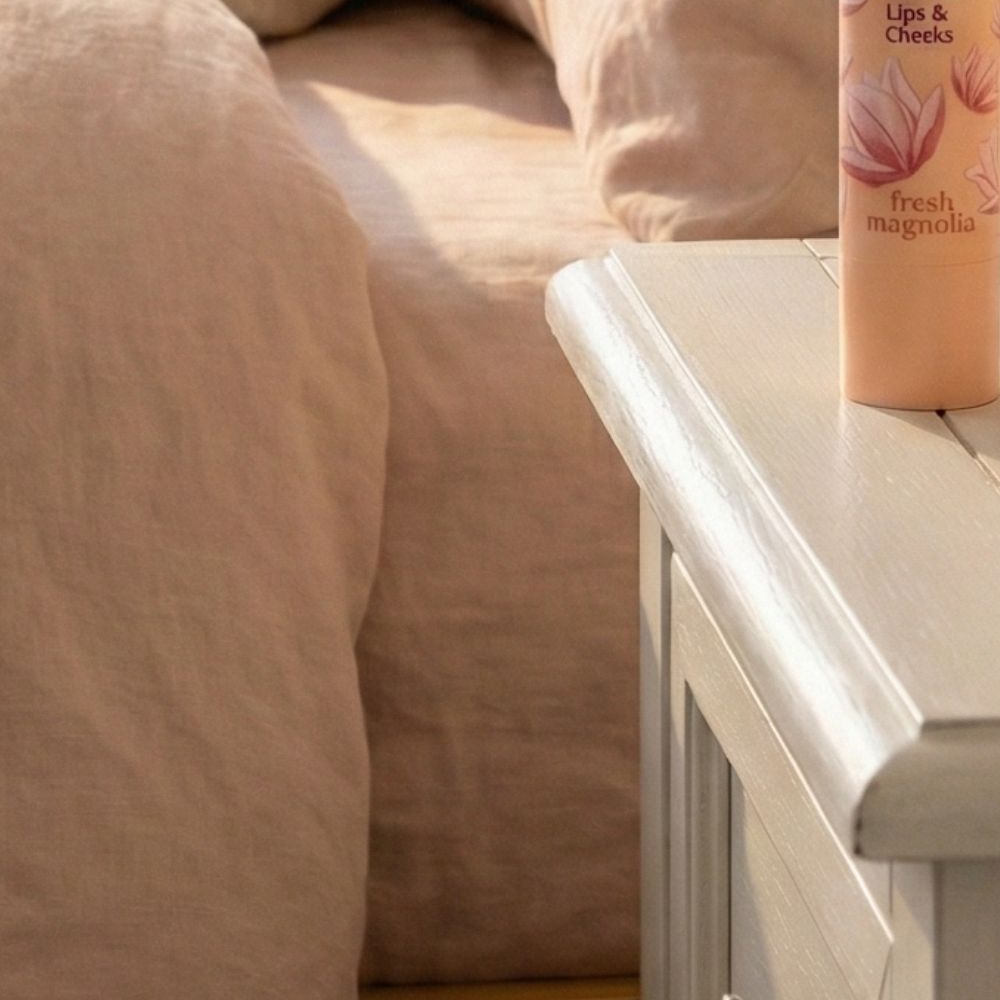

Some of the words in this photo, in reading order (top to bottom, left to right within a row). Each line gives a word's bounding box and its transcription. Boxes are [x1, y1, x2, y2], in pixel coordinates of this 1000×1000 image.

[886, 3, 926, 26] Lips
[931, 4, 949, 21] &
[885, 25, 954, 44] Cheeks
[890, 190, 955, 212] fresh
[866, 213, 976, 240] magnolia
